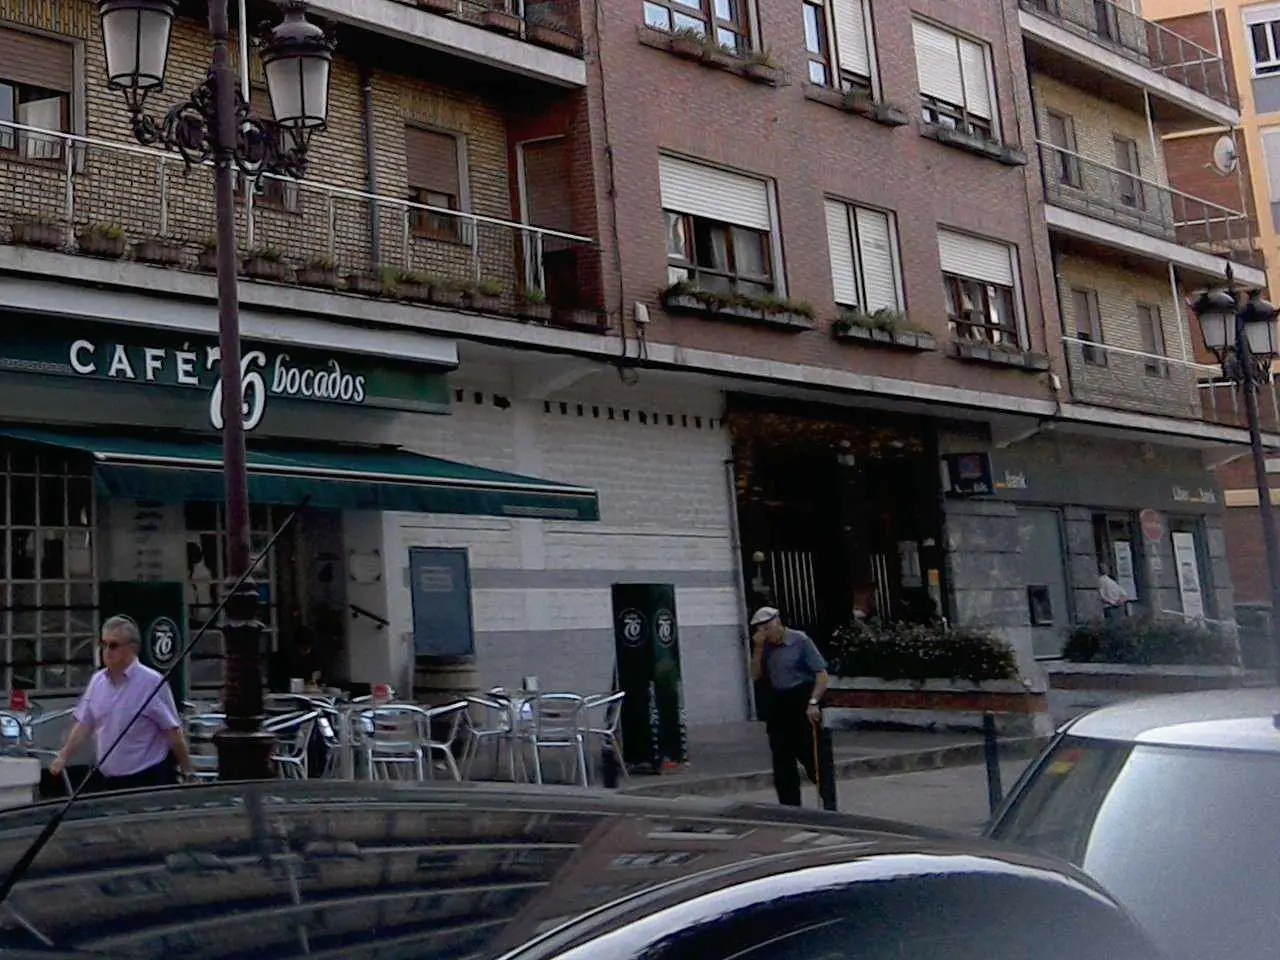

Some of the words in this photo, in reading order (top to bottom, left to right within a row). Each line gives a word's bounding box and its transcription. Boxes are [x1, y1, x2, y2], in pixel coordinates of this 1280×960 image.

[69, 339, 200, 386] CAFÉ
[271, 353, 365, 402] bocados
[155, 631, 174, 654] 76
